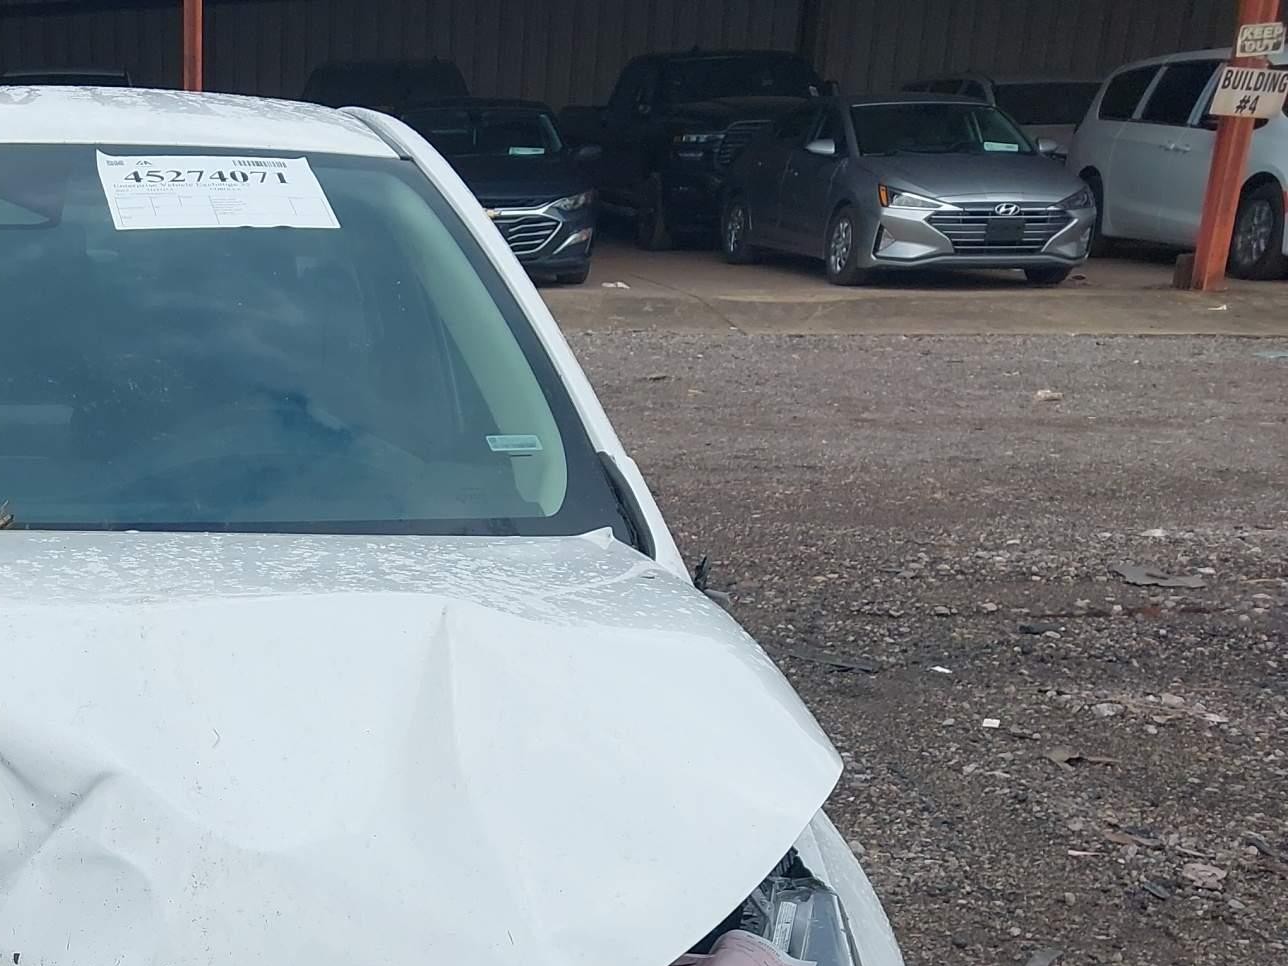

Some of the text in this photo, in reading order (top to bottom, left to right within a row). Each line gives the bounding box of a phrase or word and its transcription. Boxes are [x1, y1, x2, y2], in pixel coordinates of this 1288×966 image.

[1241, 26, 1283, 40] KEEP
[1244, 40, 1275, 52] OUT
[1221, 69, 1288, 93] BUILDING
[1234, 95, 1260, 114] #4
[123, 170, 289, 184] 45274071
